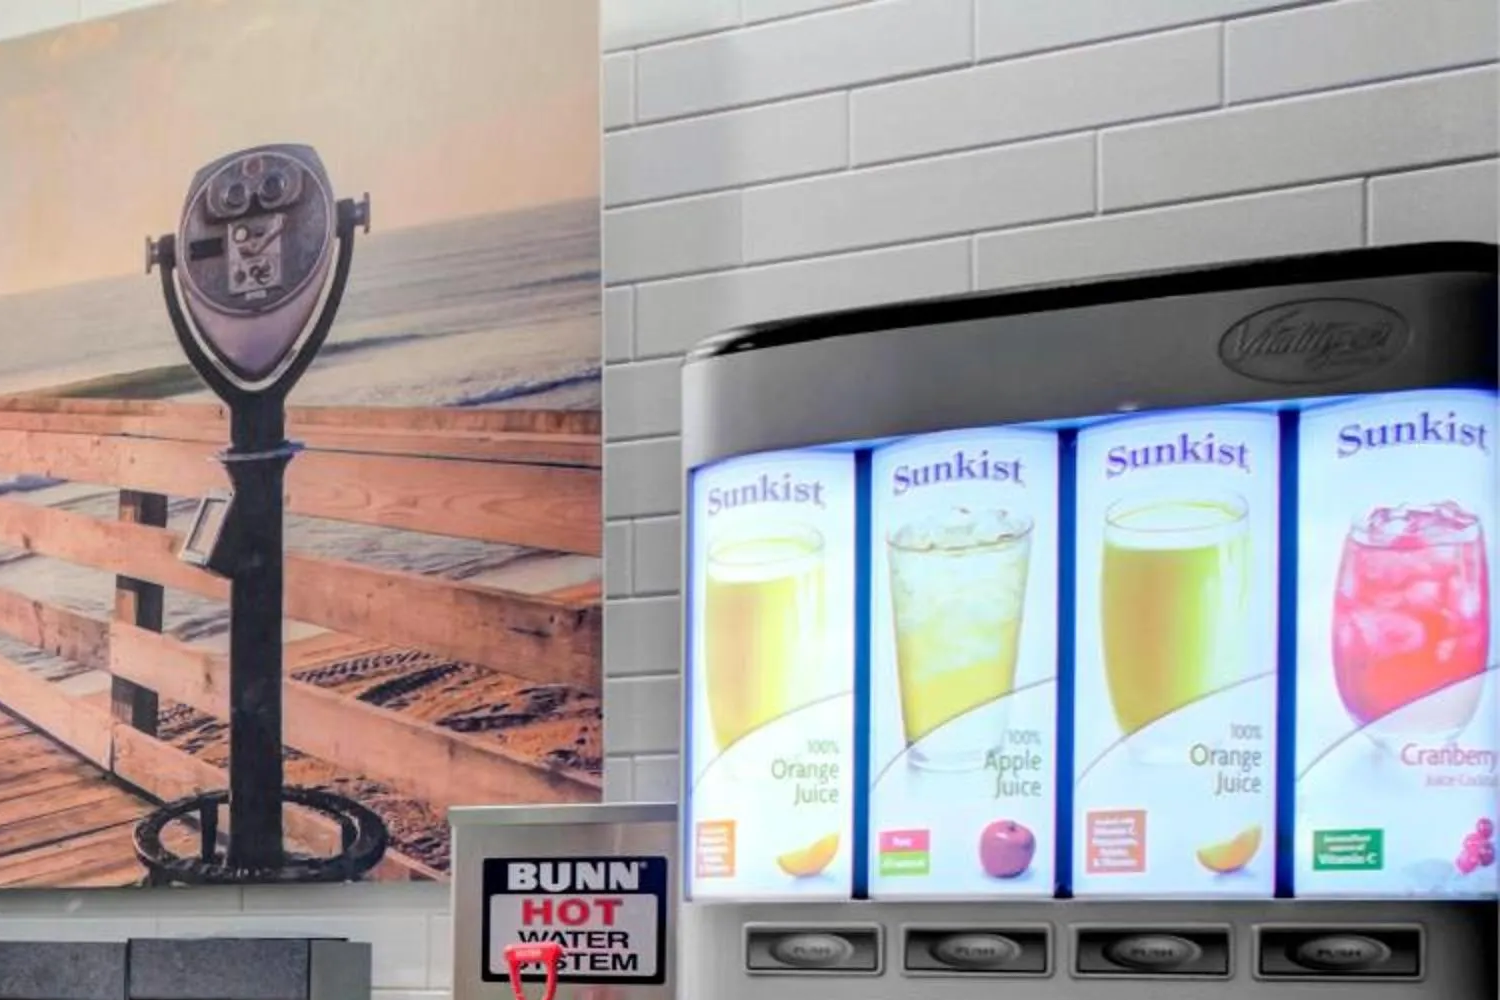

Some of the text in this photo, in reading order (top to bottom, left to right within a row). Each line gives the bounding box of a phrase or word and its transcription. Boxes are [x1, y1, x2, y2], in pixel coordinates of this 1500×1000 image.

[1337, 410, 1491, 460] Sunkist
[1105, 431, 1252, 479] Sunkist
[891, 449, 1027, 497] Sunkist
[707, 473, 826, 517] Sunkist
[1007, 729, 1043, 745] 100%
[1229, 723, 1263, 740] 100%
[771, 758, 840, 785] Orange
[983, 748, 1043, 779] Apple
[1189, 743, 1262, 773] Orange
[793, 783, 840, 808] Juice
[995, 771, 1042, 800] Juice
[1214, 770, 1262, 796] Juice
[508, 861, 639, 892] BUNN
[522, 898, 623, 926] HOT
[518, 930, 629, 949] WATER
[518, 952, 638, 971] STEM
